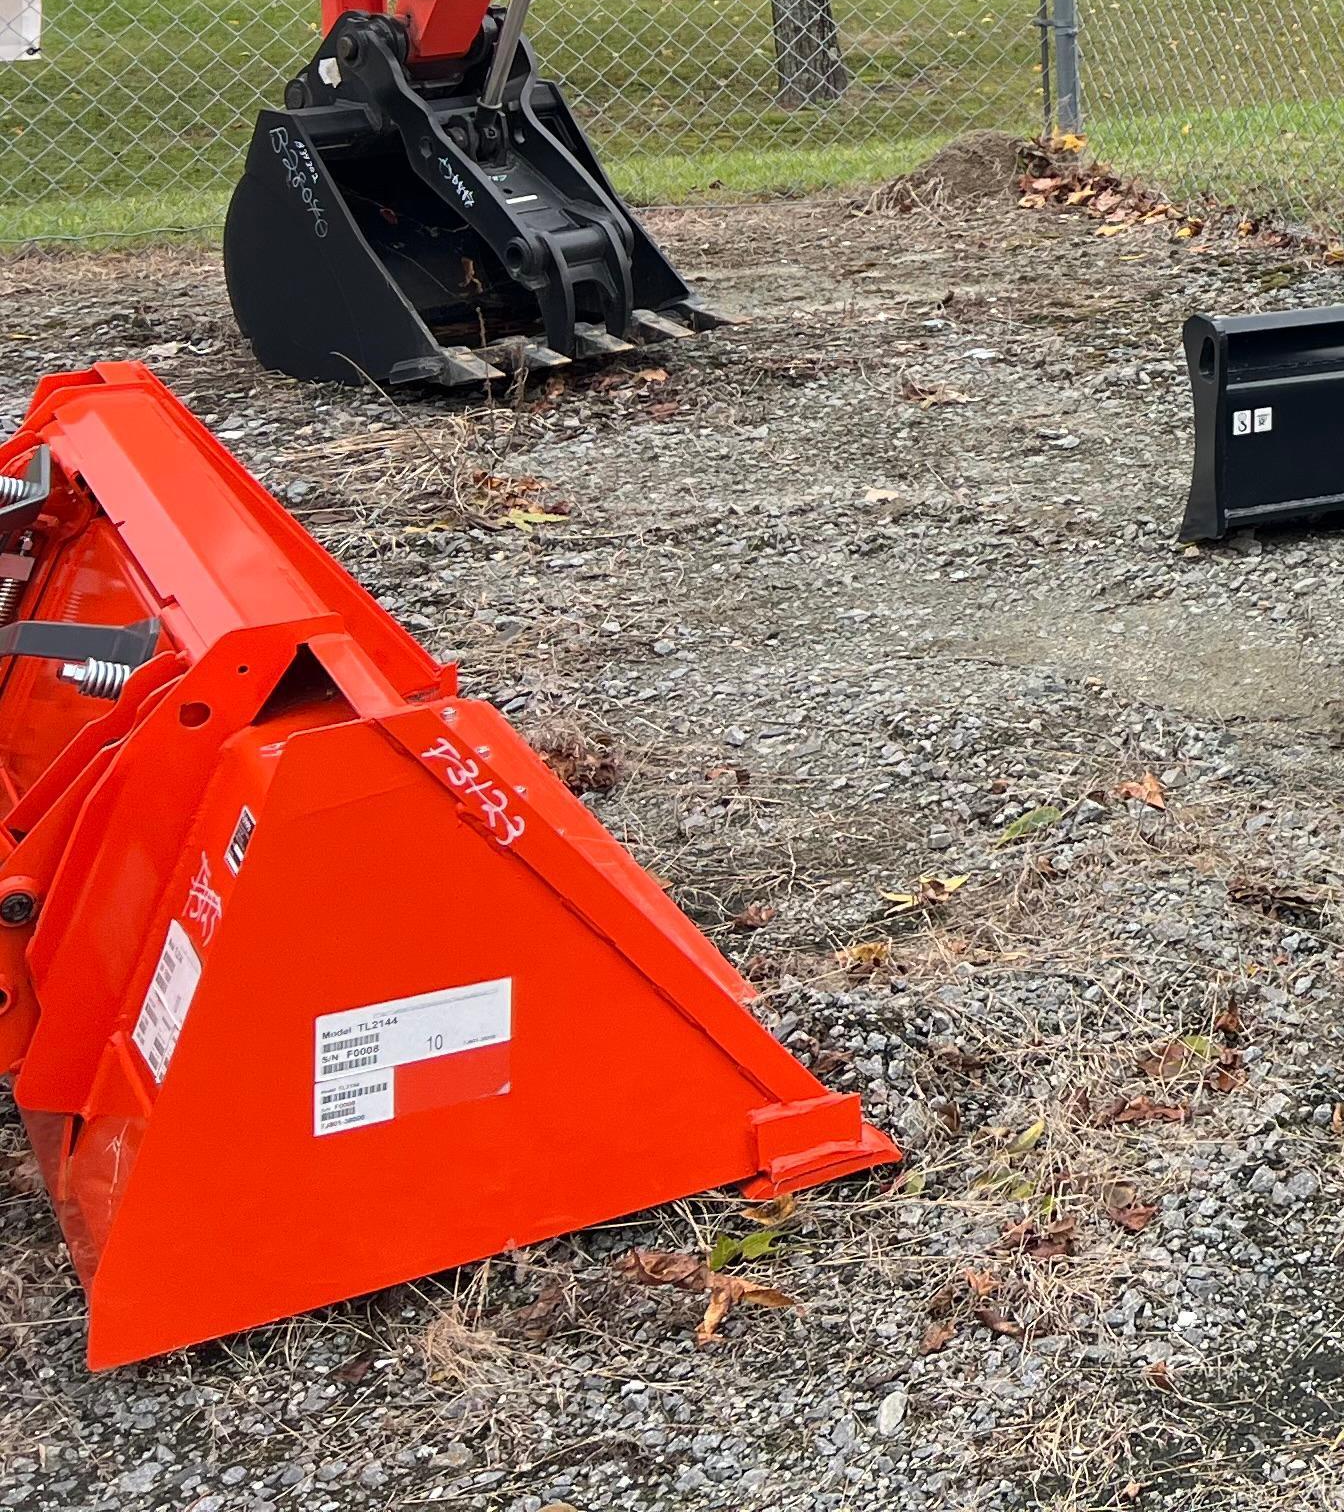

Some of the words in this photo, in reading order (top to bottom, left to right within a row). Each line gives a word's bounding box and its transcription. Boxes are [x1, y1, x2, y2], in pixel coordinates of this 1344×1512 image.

[322, 1027, 352, 1040] Model
[358, 1016, 399, 1032] TL2144
[427, 1034, 443, 1052] 10
[321, 1054, 339, 1064] S/N
